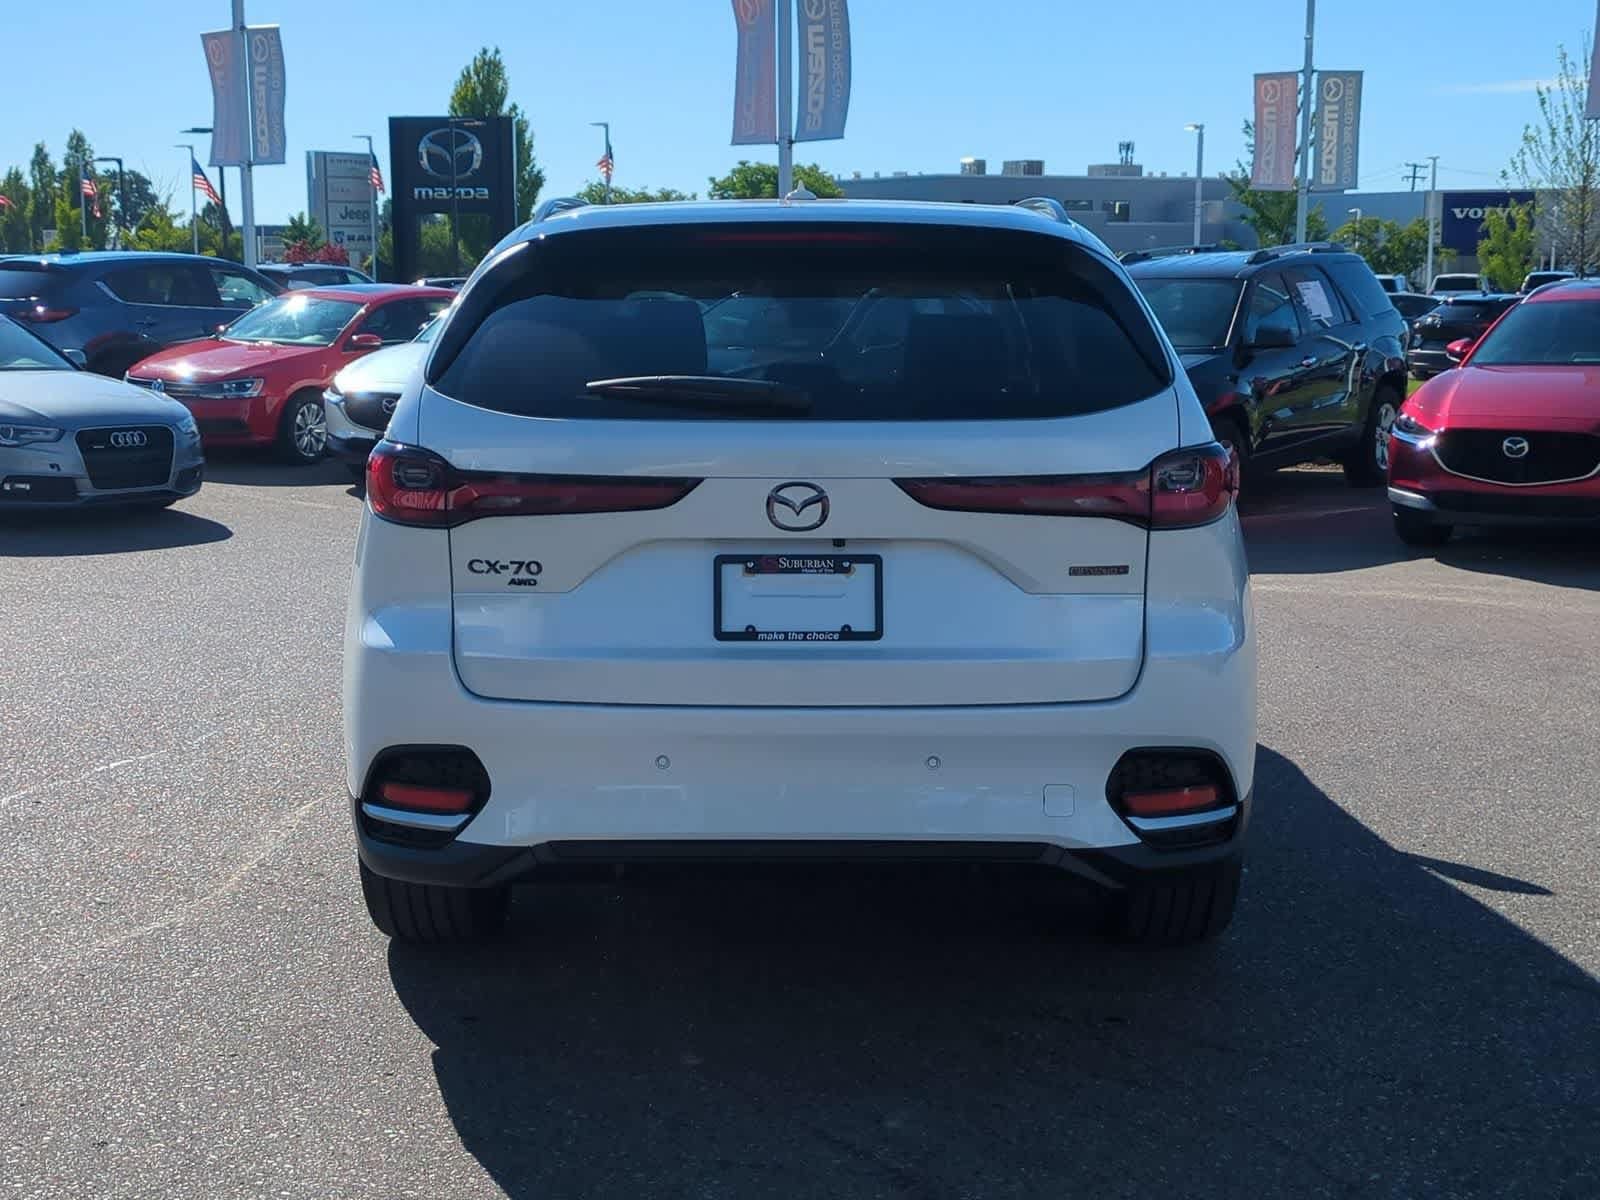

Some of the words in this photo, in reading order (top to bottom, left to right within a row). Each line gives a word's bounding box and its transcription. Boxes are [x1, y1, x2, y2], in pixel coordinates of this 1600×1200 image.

[340, 205, 370, 224] Jeep
[1450, 207, 1511, 220] VOLV
[467, 558, 543, 576] CX-70
[507, 577, 538, 587] AWD
[757, 631, 785, 641] make
[787, 631, 804, 641] the
[806, 631, 840, 641] choice
